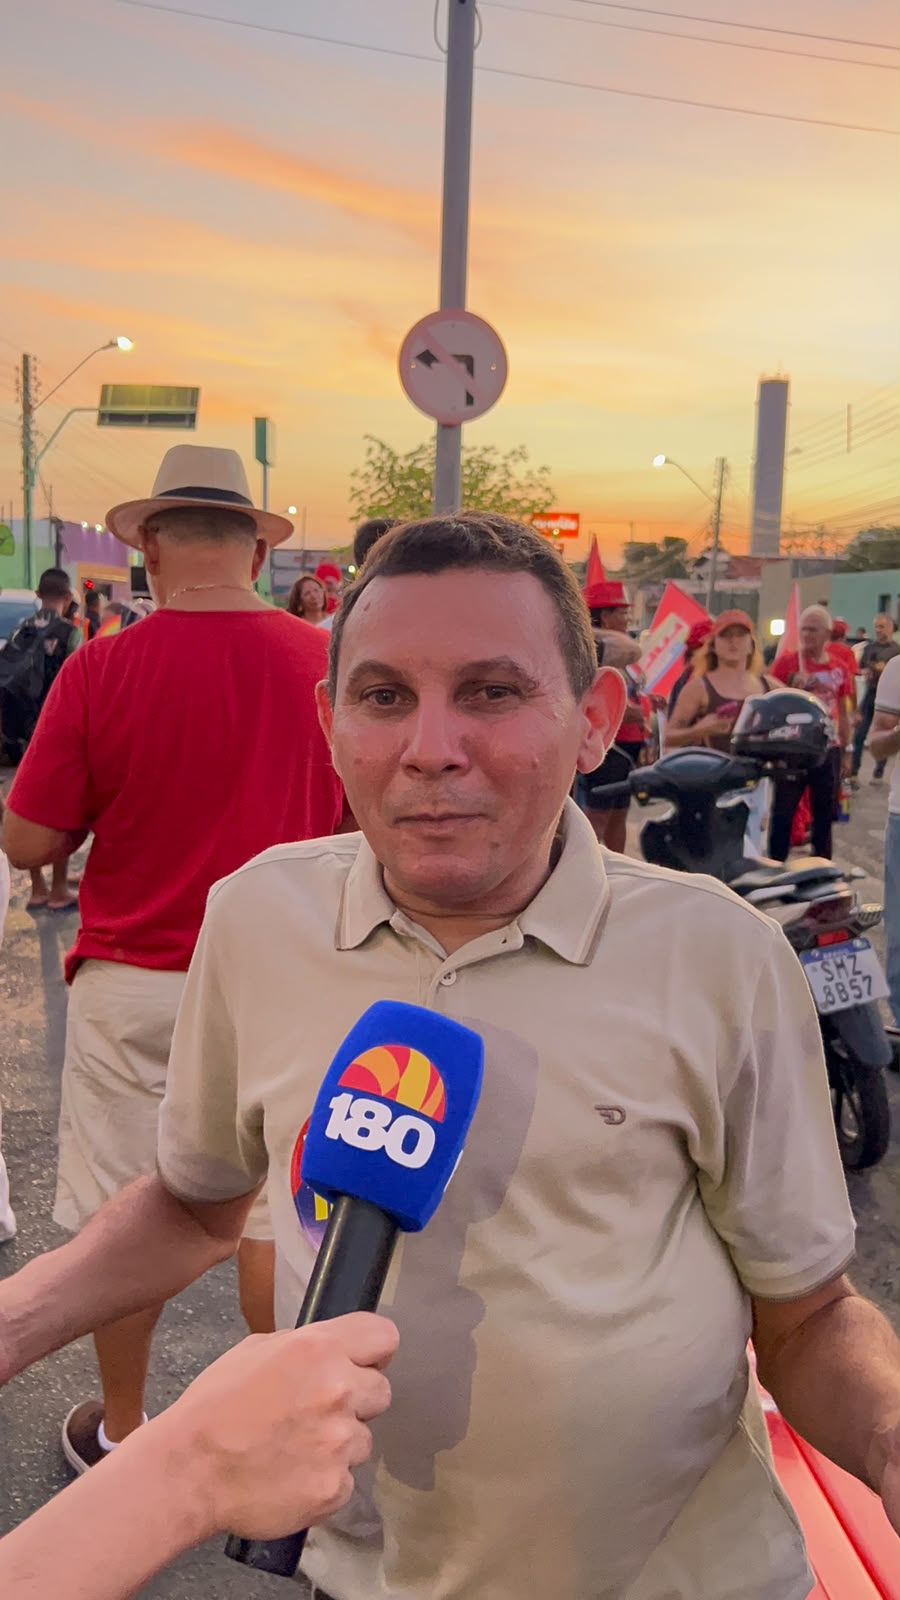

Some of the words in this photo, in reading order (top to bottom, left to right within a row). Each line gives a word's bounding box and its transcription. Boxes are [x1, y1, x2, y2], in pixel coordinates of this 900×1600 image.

[821, 955, 863, 982] SMZ
[823, 975, 872, 1005] 8B57
[325, 1092, 436, 1169] 180
